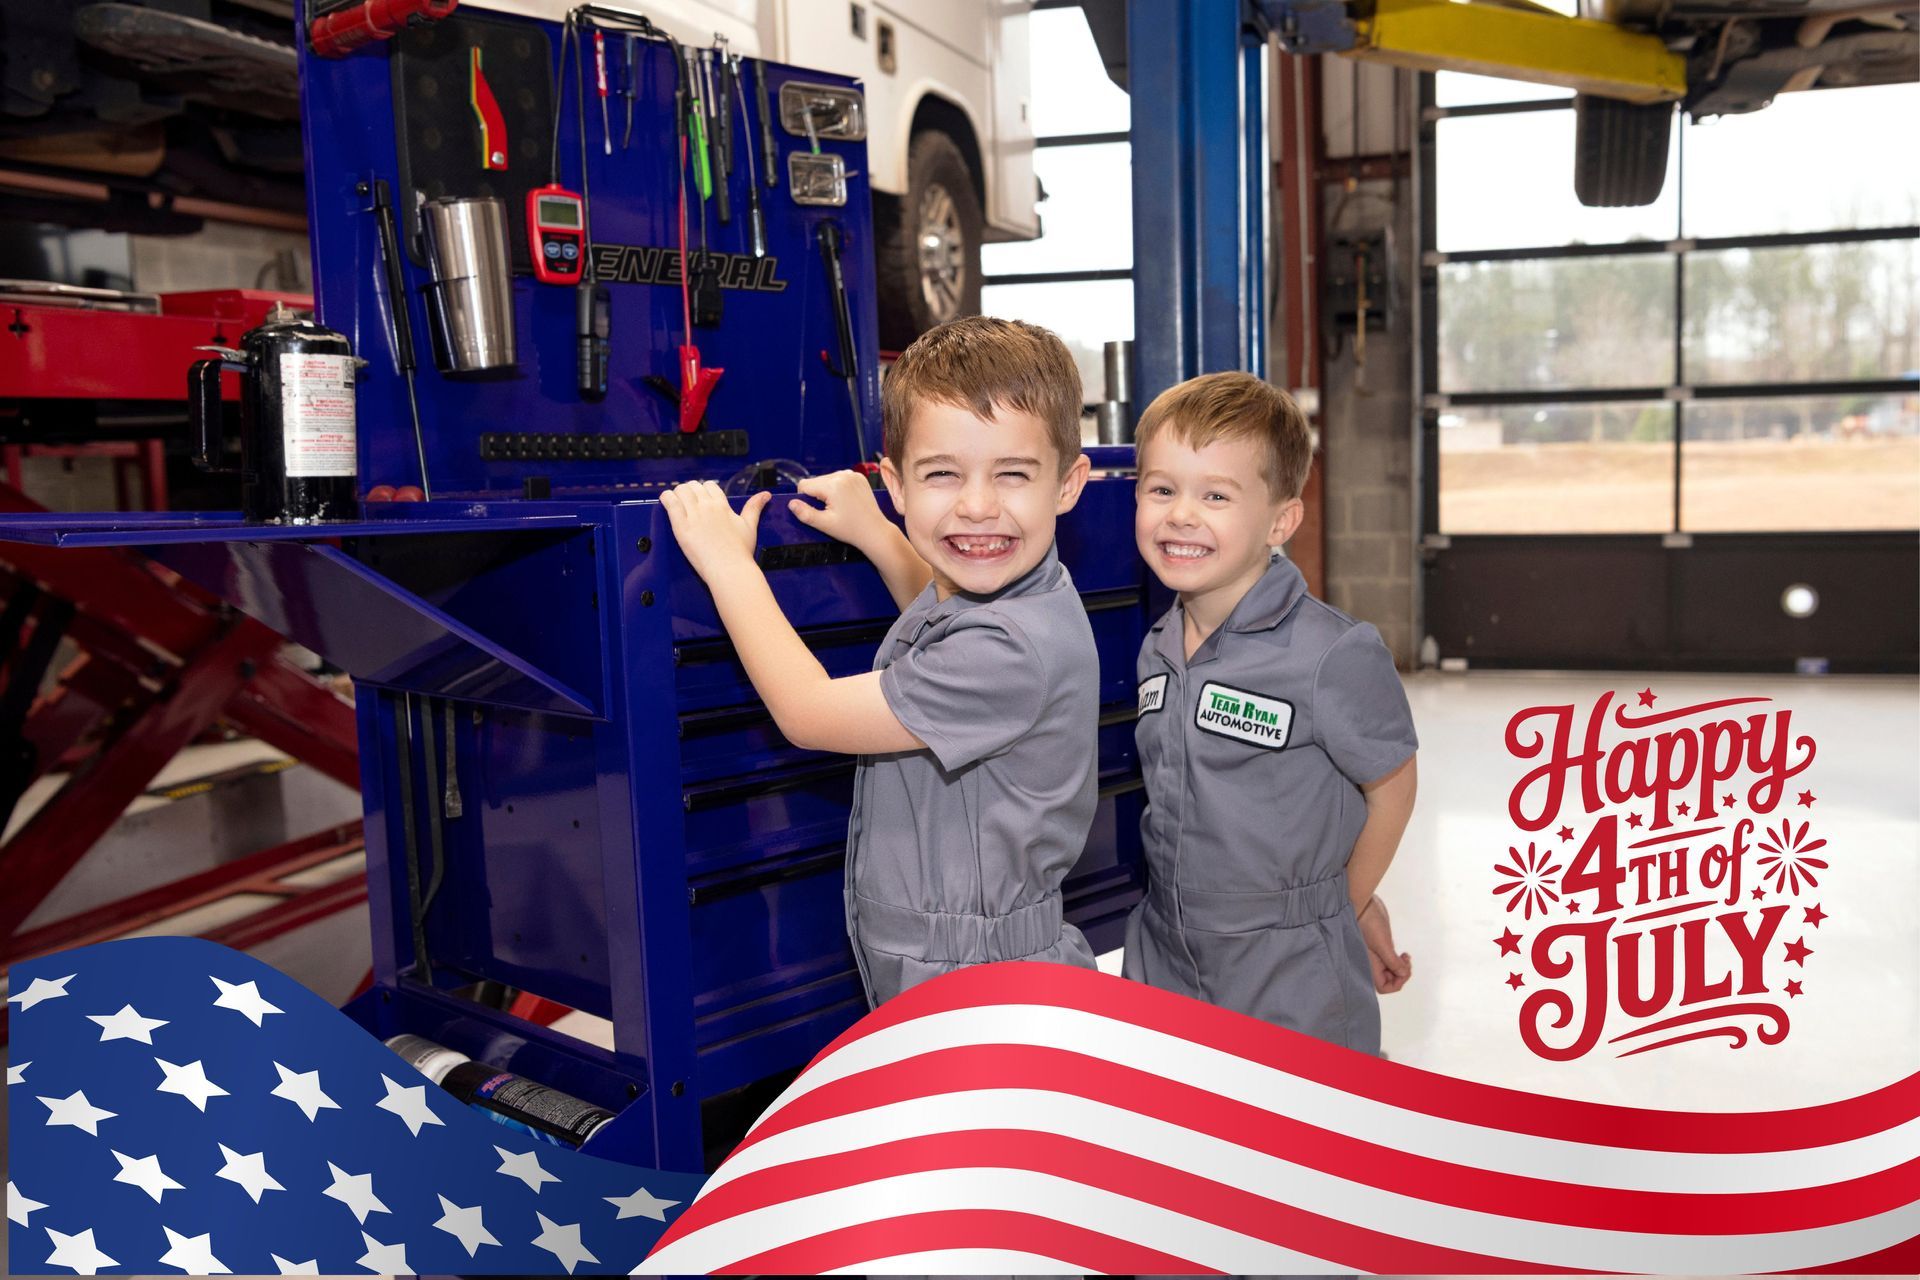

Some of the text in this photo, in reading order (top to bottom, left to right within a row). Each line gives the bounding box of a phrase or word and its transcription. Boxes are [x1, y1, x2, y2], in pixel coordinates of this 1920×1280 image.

[584, 243, 788, 292] ENERAL
[1200, 709, 1282, 740] AUTOMOTIVE
[1210, 691, 1278, 726] TEAM RYAN
